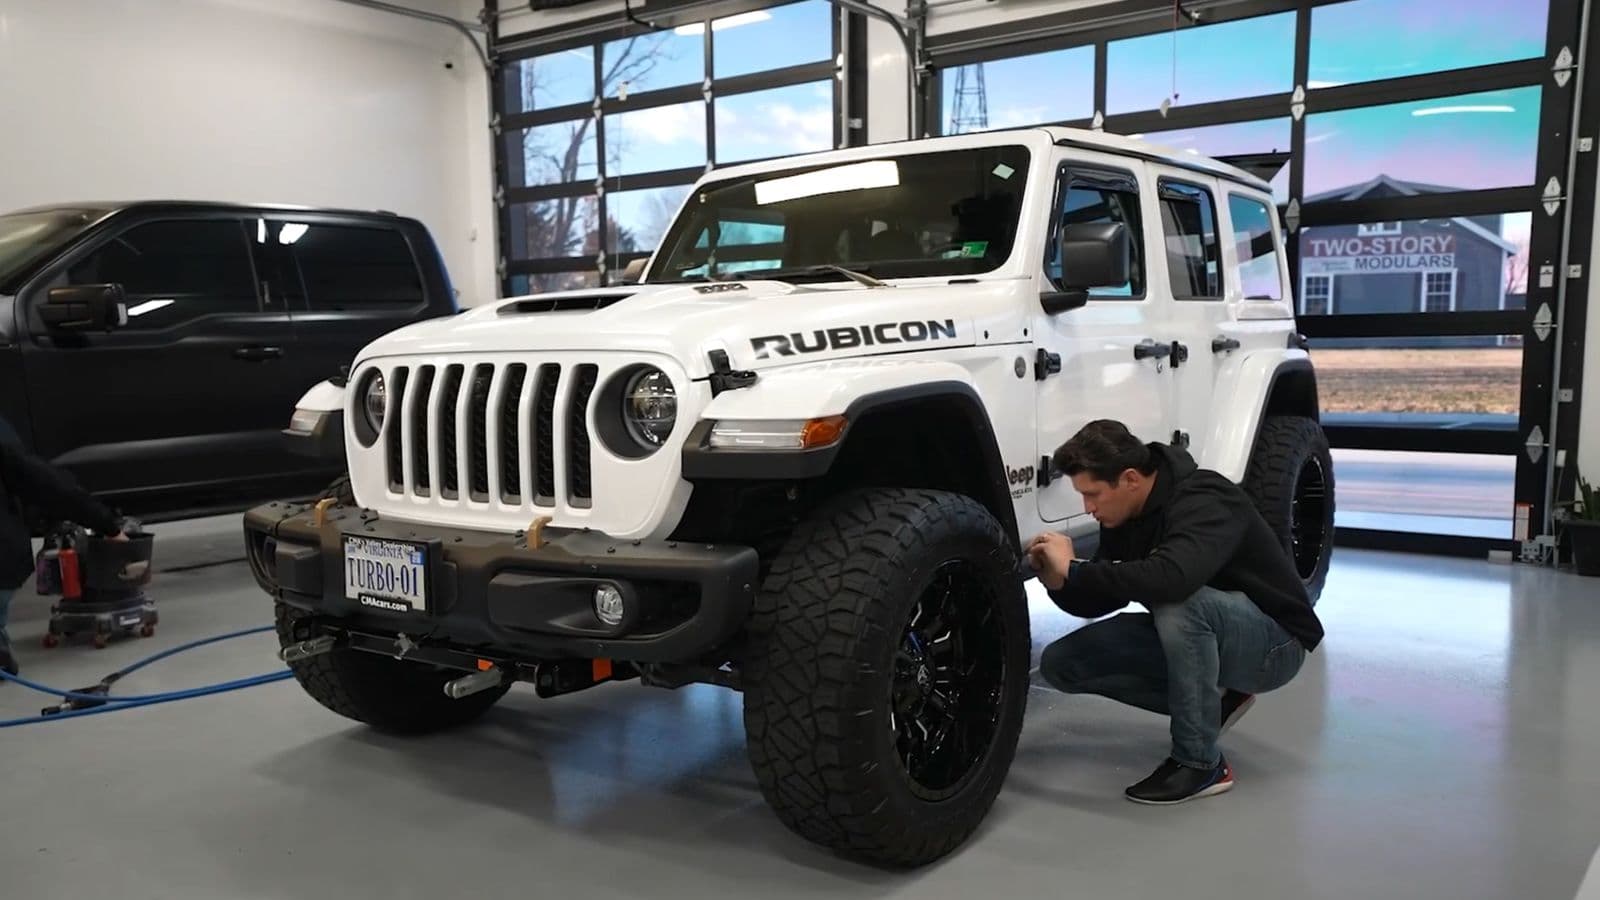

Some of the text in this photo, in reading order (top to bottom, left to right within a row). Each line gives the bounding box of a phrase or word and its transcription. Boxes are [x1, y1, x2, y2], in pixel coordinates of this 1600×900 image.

[1310, 235, 1452, 256] TWO-STORY
[1354, 256, 1452, 270] MODULARS
[749, 319, 957, 360] RUBICON
[347, 557, 418, 596] TURBO-01
